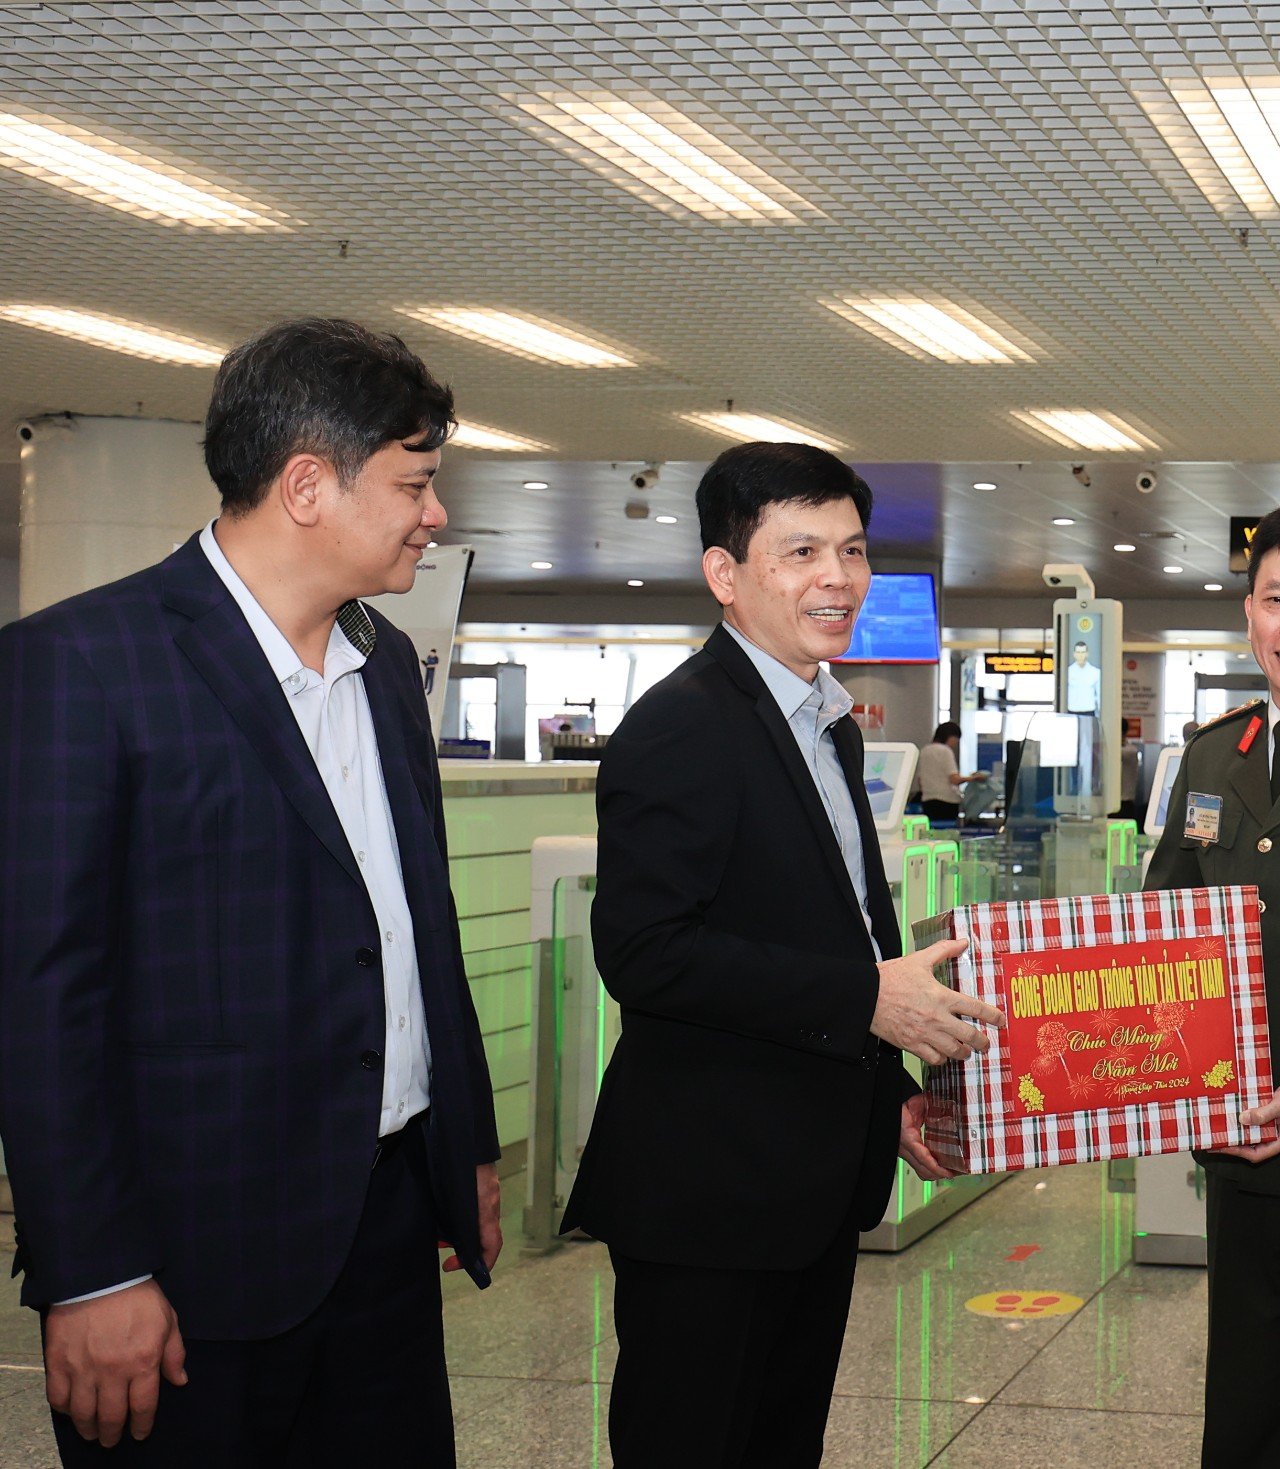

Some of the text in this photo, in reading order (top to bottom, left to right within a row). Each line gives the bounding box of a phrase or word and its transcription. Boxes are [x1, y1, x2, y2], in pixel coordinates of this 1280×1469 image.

[1011, 968, 1042, 1019] CÔNG
[1073, 969, 1099, 1013] GIAO
[1099, 959, 1136, 1010] THÔNG
[1135, 956, 1158, 1014] VẬN
[1157, 949, 1176, 1004] TẢI
[1175, 952, 1199, 1010] VIỆT
[1199, 957, 1225, 1000] NAM
[1067, 1031, 1106, 1051] Chúc
[1168, 1076, 1190, 1089] 2024
